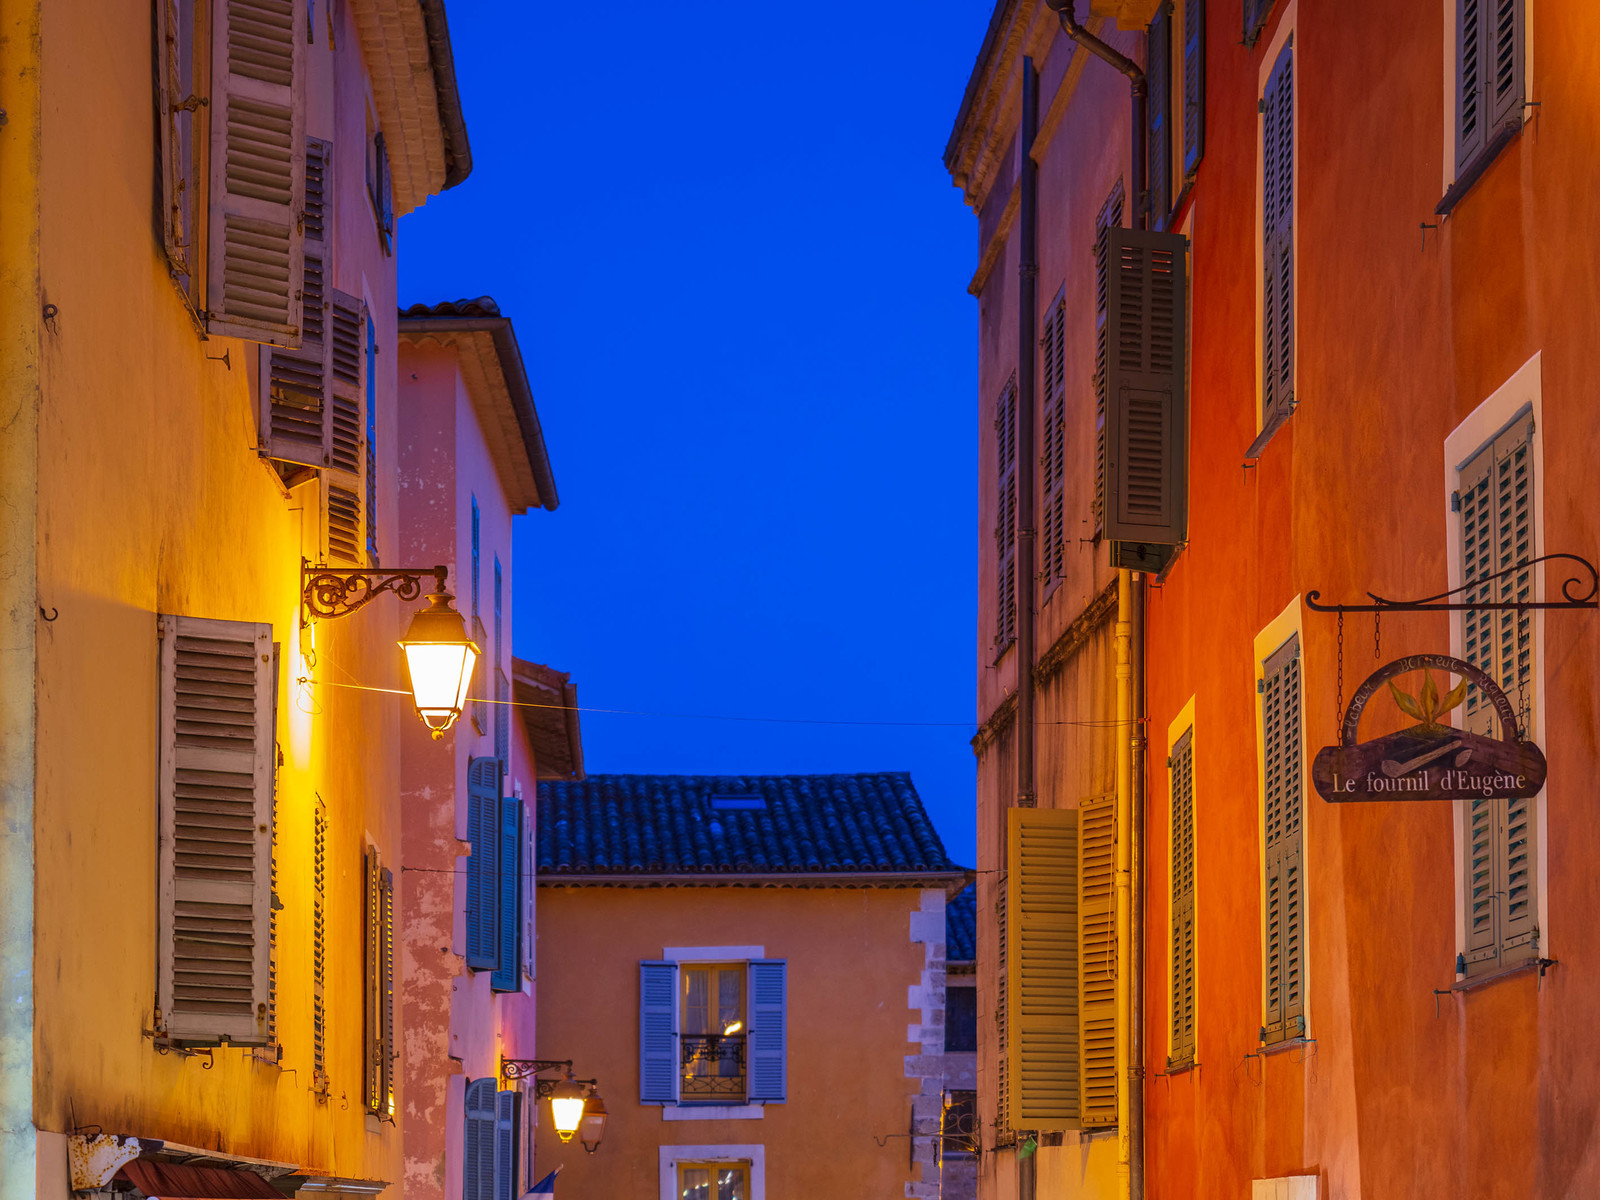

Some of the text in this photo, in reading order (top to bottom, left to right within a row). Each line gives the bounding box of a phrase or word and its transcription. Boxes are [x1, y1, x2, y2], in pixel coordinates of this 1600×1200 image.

[1332, 770, 1526, 797] Le fournil d'Eugène
